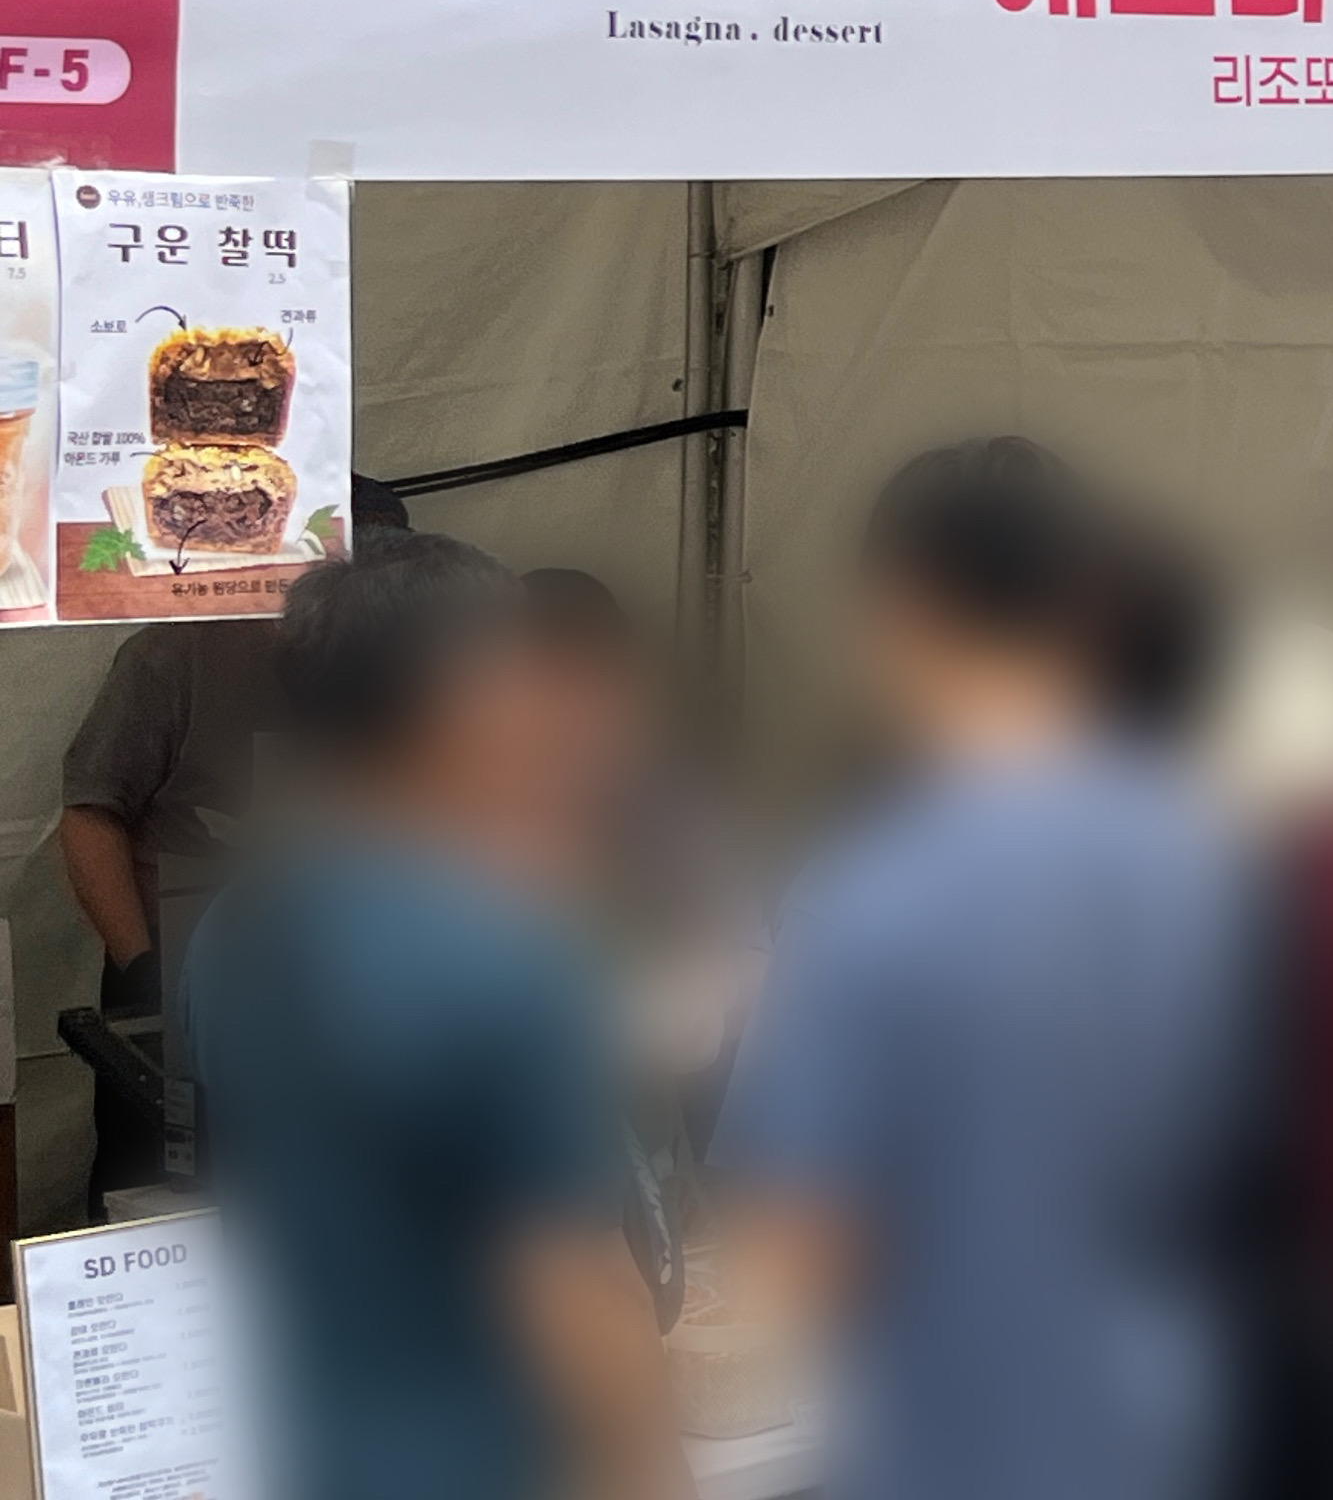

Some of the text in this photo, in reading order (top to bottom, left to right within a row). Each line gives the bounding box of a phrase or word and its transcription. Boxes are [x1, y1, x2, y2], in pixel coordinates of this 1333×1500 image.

[606, 10, 884, 46] Lasagna dessert
[0, 47, 89, 92] F-5
[107, 223, 298, 269] 구운 찰떡
[83, 1243, 188, 1280] SD FOOD
